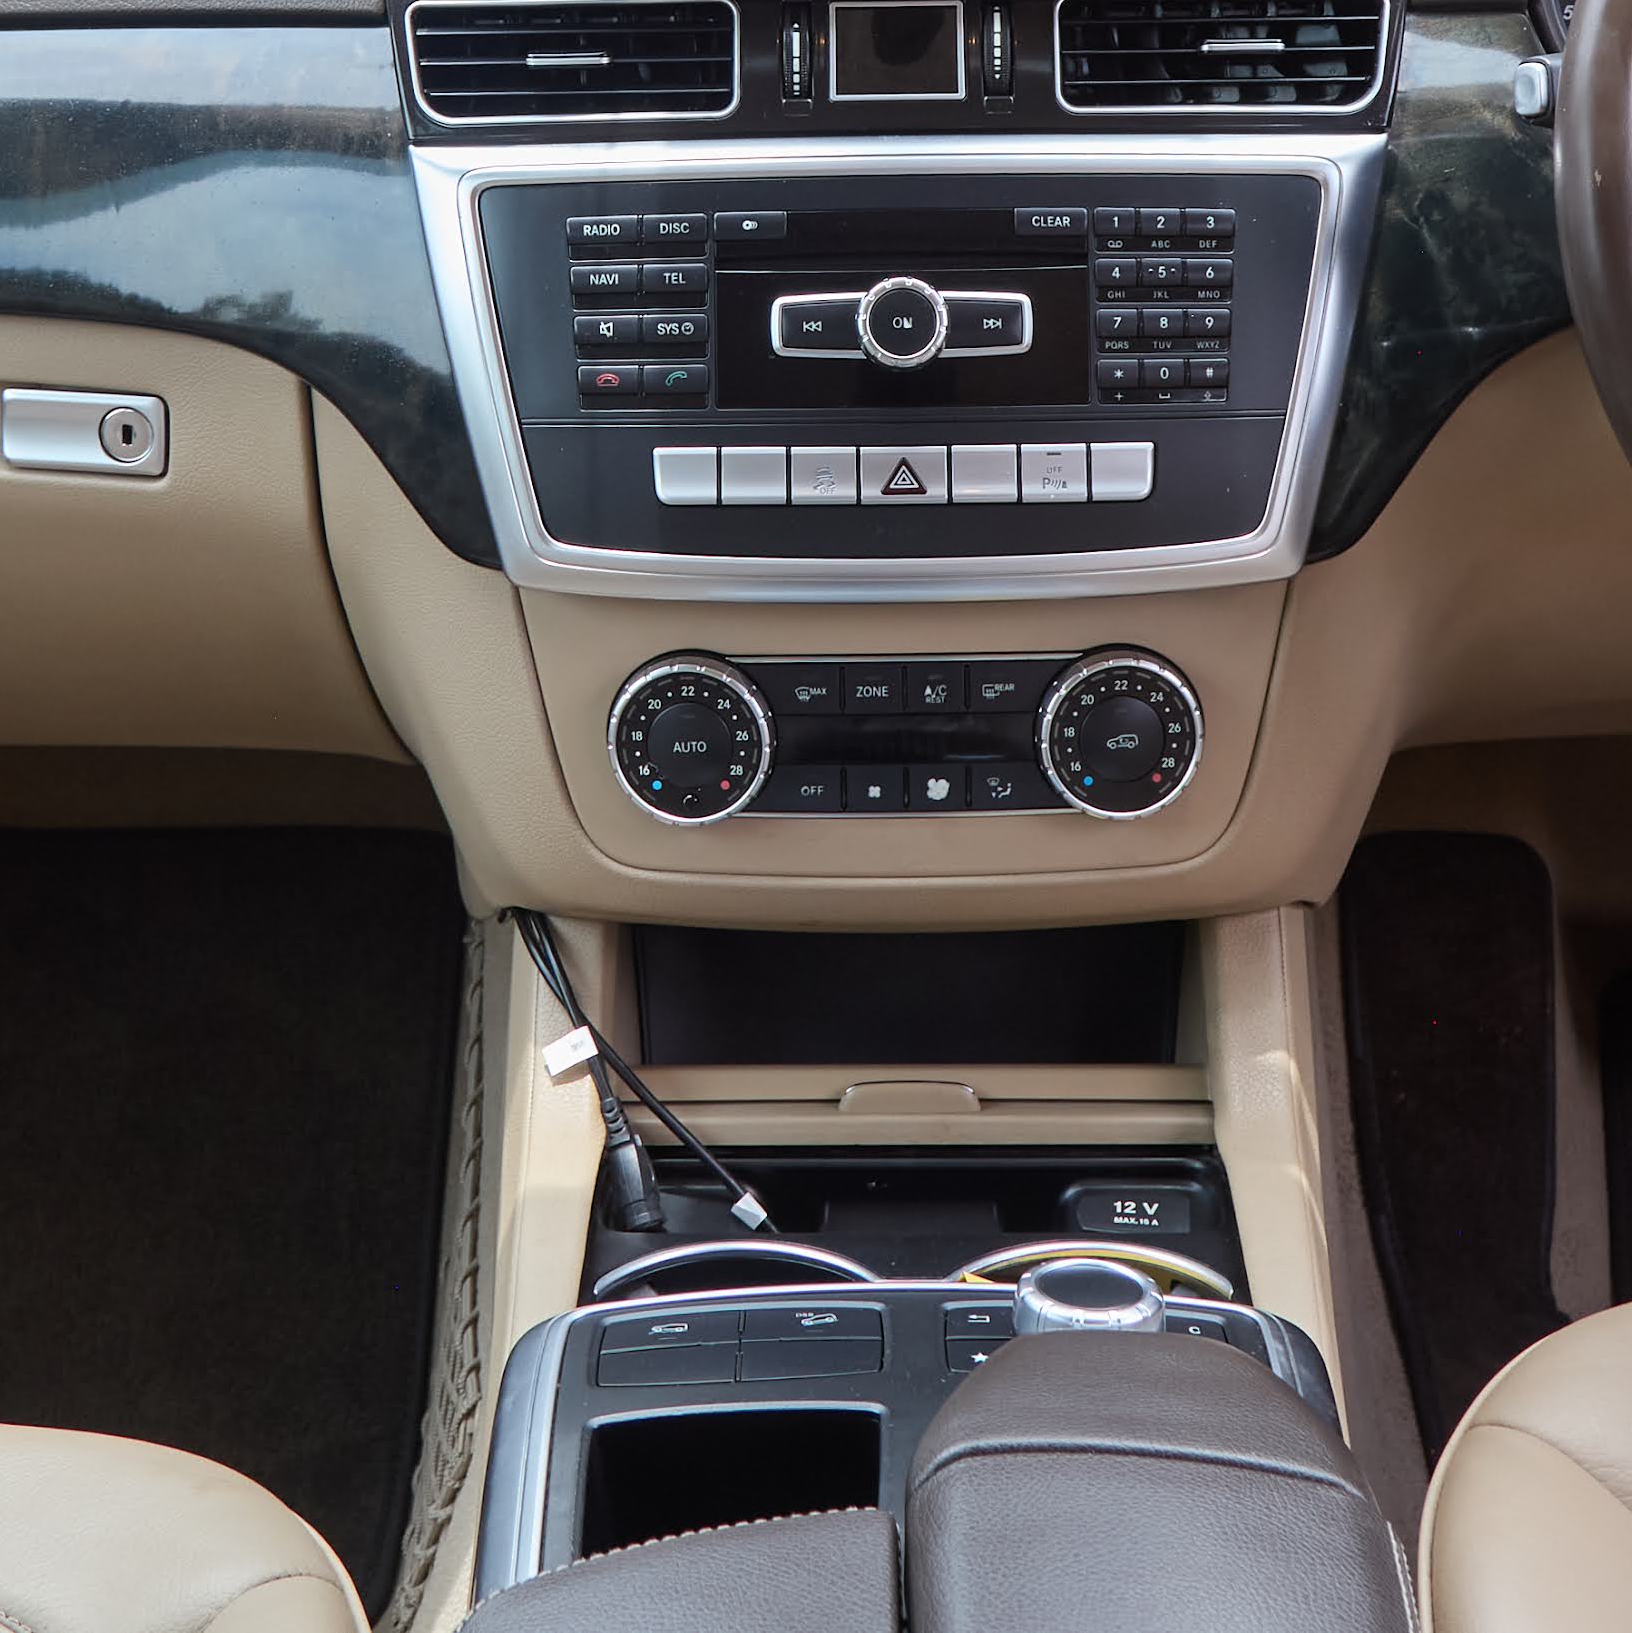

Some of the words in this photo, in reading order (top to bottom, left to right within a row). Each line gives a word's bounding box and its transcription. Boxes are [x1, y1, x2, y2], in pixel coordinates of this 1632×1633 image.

[1031, 215, 1071, 228] CLEAR
[1112, 216, 1119, 228] 1
[1156, 216, 1166, 229] 2
[1206, 216, 1215, 229] 3
[582, 224, 621, 237] RADIO
[659, 222, 690, 235] DISC
[1150, 239, 1171, 249] ABC
[1198, 239, 1218, 249] DEF
[1111, 266, 1121, 279] 4
[1157, 265, 1167, 279] 5
[1205, 266, 1215, 279] 6
[589, 273, 620, 286] NAVI
[663, 272, 687, 285] TEL
[1107, 290, 1126, 299] GHI
[1152, 290, 1170, 299] JKL
[1197, 290, 1221, 299] MNO
[892, 316, 913, 329] ON
[1112, 317, 1122, 329] 7
[1159, 317, 1169, 329] 8
[1205, 316, 1215, 329] 9
[656, 322, 680, 336] SYS
[1105, 340, 1130, 350] PQRS
[1152, 340, 1172, 350] TUV
[1196, 340, 1220, 350] WXYZ
[1159, 366, 1169, 380] 0
[923, 684, 947, 698] A/C
[994, 683, 1015, 692] REAR
[1114, 680, 1129, 691] 22
[680, 686, 695, 697] 22
[809, 687, 827, 696] MAX
[855, 686, 889, 698] ZONE
[1150, 691, 1164, 702] 24
[647, 699, 662, 710] 20
[717, 699, 731, 710] 24
[925, 696, 946, 704] REST
[1080, 694, 1094, 705] 20
[1064, 727, 1076, 738] 18
[1167, 722, 1182, 733] 26
[631, 731, 643, 742] 18
[735, 730, 749, 742] 26
[672, 740, 707, 753] AUTO
[1070, 761, 1082, 772] 16
[1161, 757, 1176, 768] 28
[638, 765, 651, 776] 16
[729, 765, 744, 776] 28
[800, 785, 824, 797] OFF
[1113, 1200, 1137, 1214] 12
[1142, 1202, 1159, 1216] V
[1151, 1218, 1159, 1226] A
